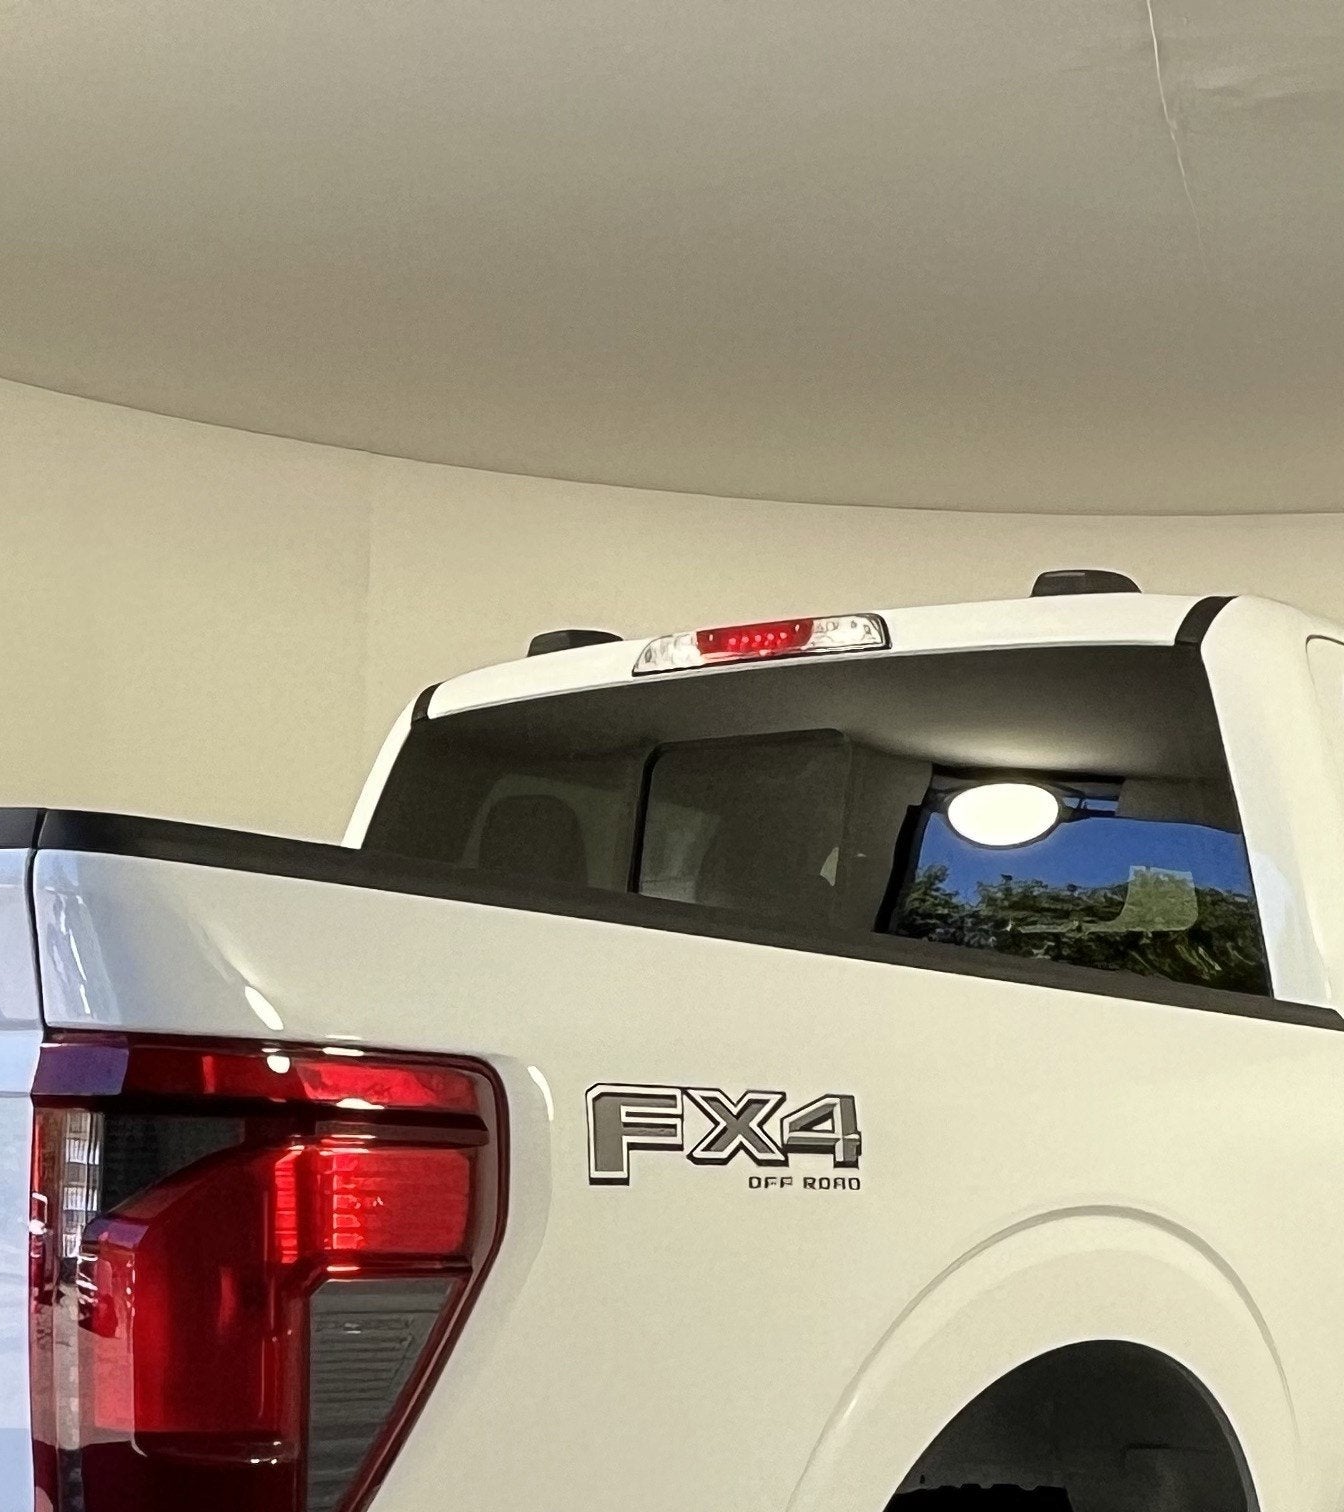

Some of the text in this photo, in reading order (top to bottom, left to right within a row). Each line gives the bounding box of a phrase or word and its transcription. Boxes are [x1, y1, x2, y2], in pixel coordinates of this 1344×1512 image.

[585, 1083, 862, 1186] FX4
[748, 1175, 862, 1191] OFF ROAD
